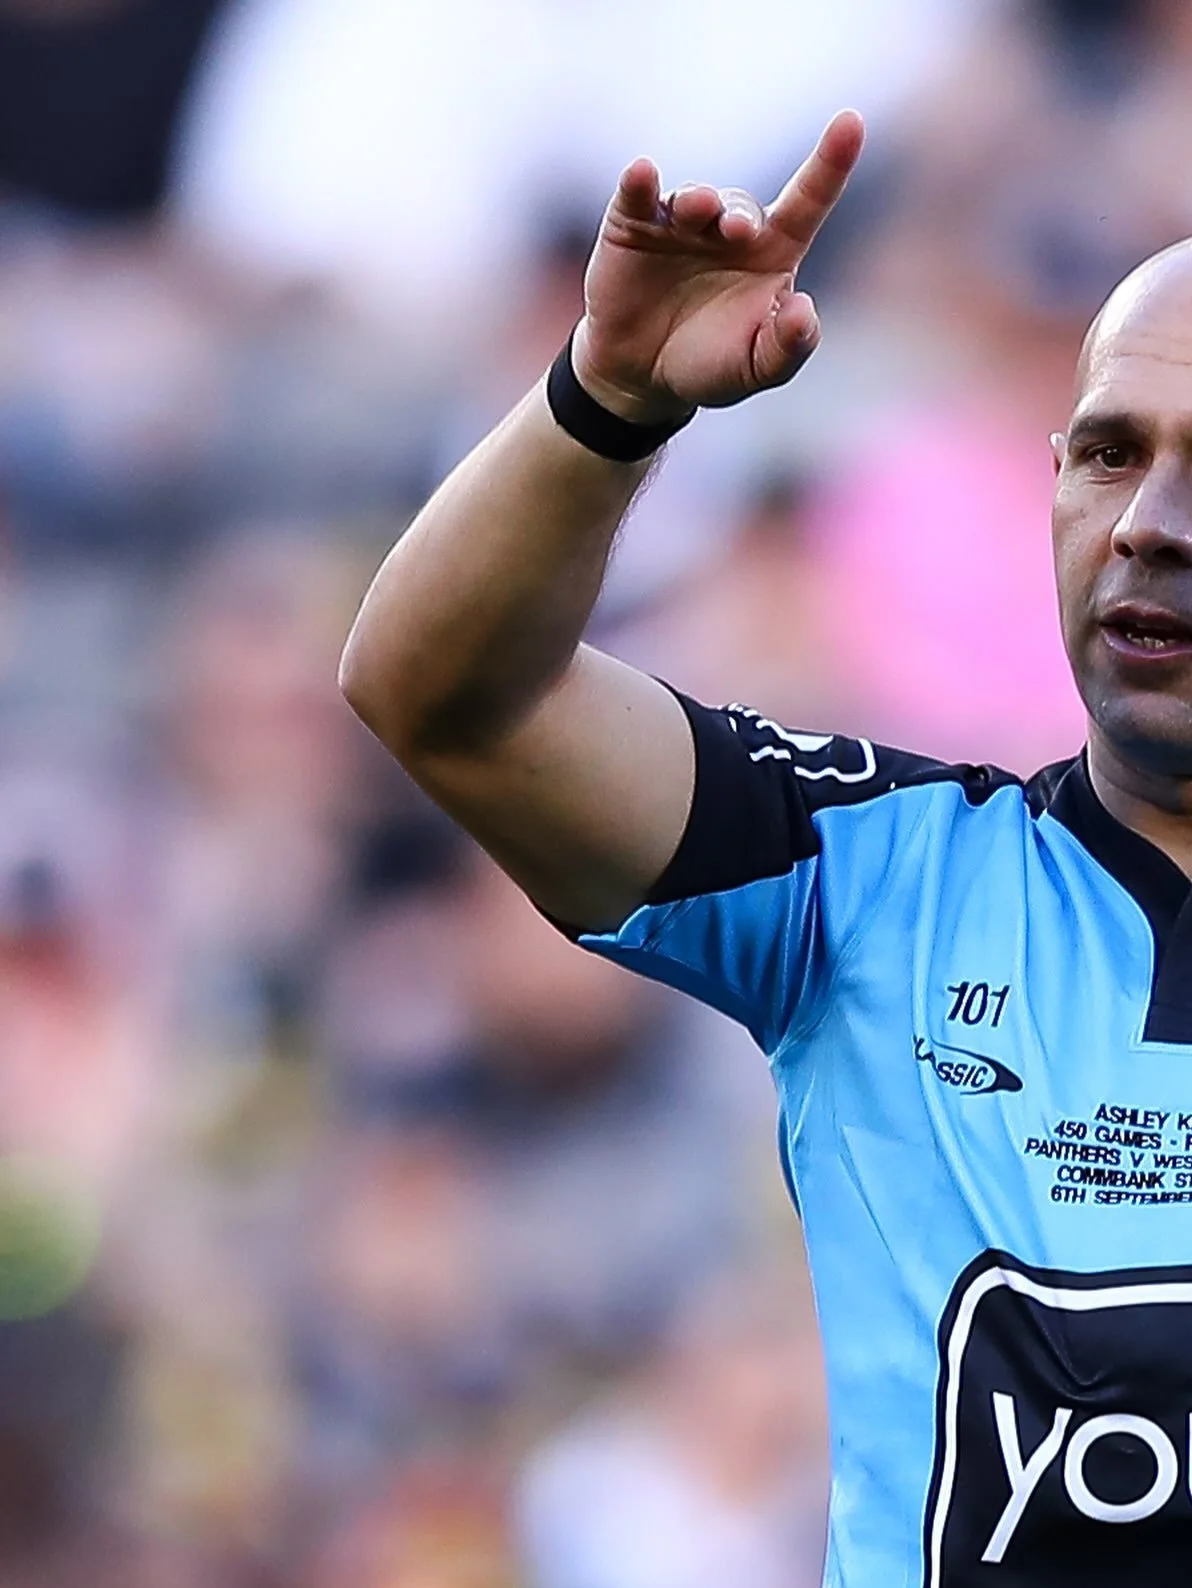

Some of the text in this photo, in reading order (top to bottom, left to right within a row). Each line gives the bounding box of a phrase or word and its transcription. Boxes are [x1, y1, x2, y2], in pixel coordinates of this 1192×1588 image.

[947, 981, 1010, 1027] 101
[912, 1034, 989, 1088] LASSIC
[1095, 1103, 1170, 1130] ASHLEY
[1054, 1120, 1087, 1140] 450
[1095, 1125, 1162, 1149] GAMES
[1024, 1138, 1121, 1166] PANTHERS
[1130, 1151, 1144, 1168] V
[1057, 1164, 1166, 1189] COMMBANK
[1051, 1185, 1086, 1203] 6TH
